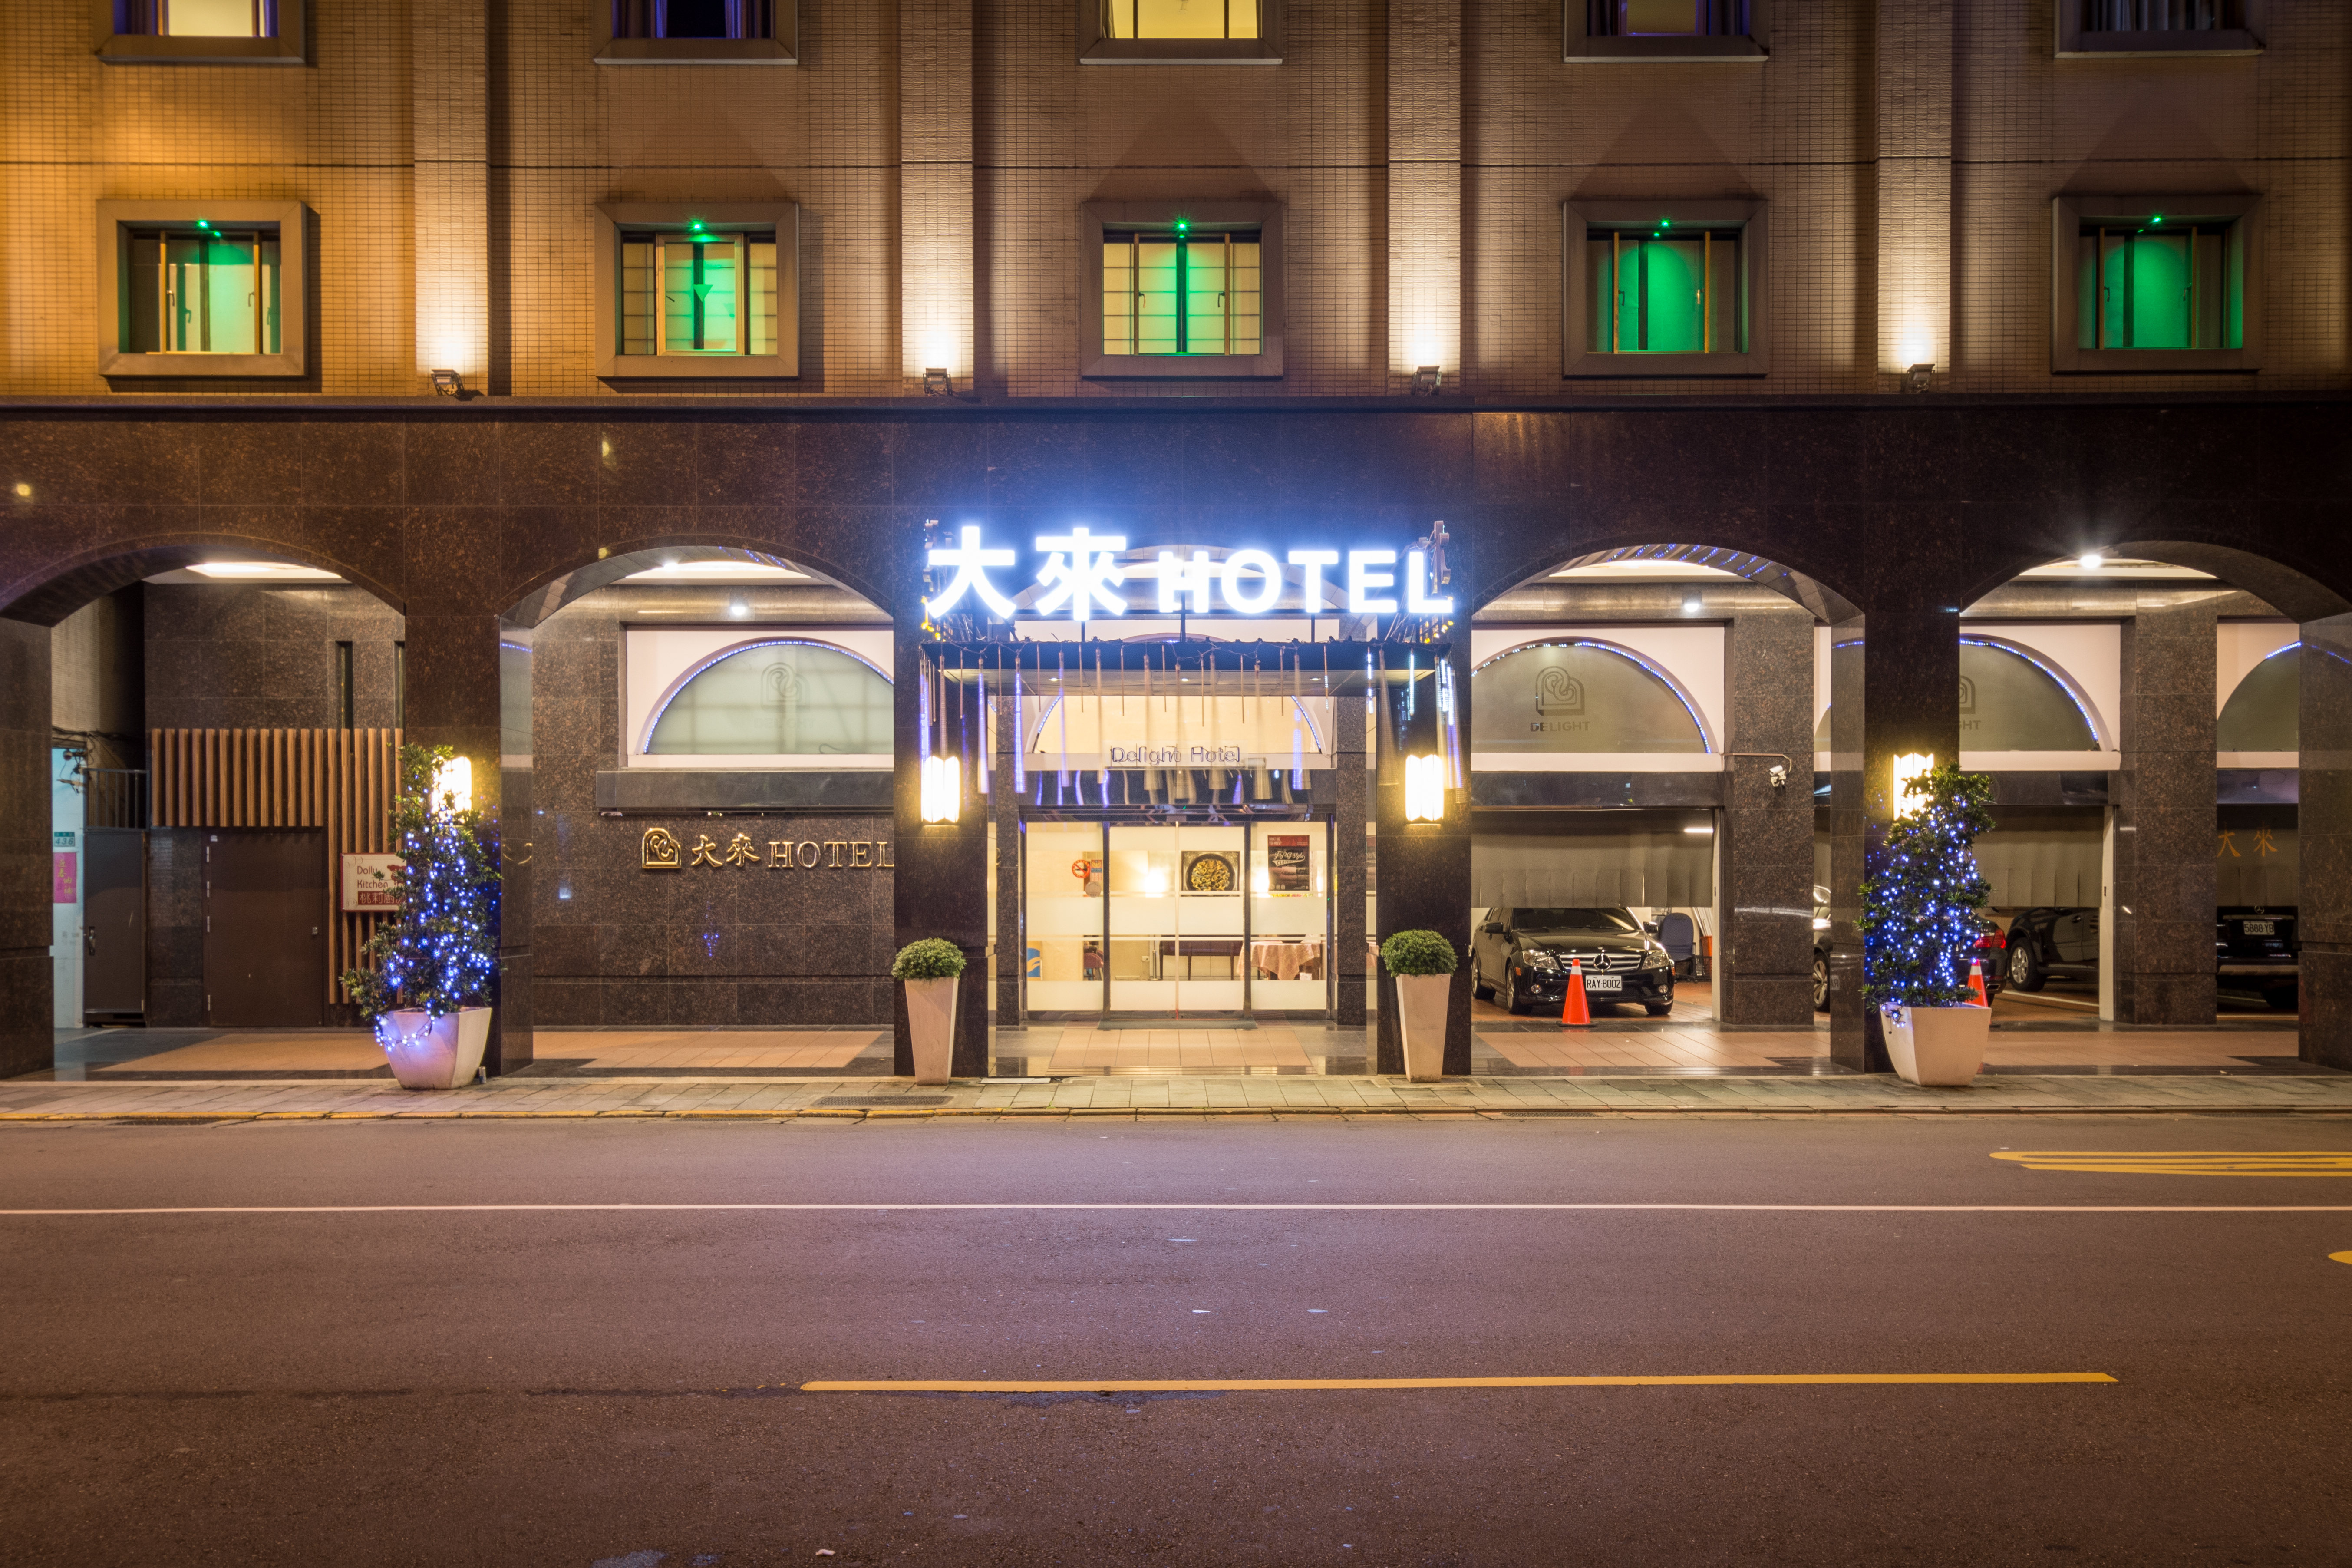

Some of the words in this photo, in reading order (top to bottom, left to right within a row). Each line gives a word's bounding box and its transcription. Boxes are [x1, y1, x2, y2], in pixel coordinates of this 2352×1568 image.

[926, 526, 1128, 621] 大來
[1158, 549, 1453, 614] HOTEL
[1530, 721, 1590, 732] DELIGHT
[1112, 746, 1181, 766] Delight
[1191, 746, 1240, 762] Hotel
[2217, 820, 2278, 858] 大來
[690, 833, 761, 868] 大來
[768, 841, 894, 868] HOTEL
[357, 879, 388, 888] Kitchen
[1587, 979, 1621, 988] RAY-8002
